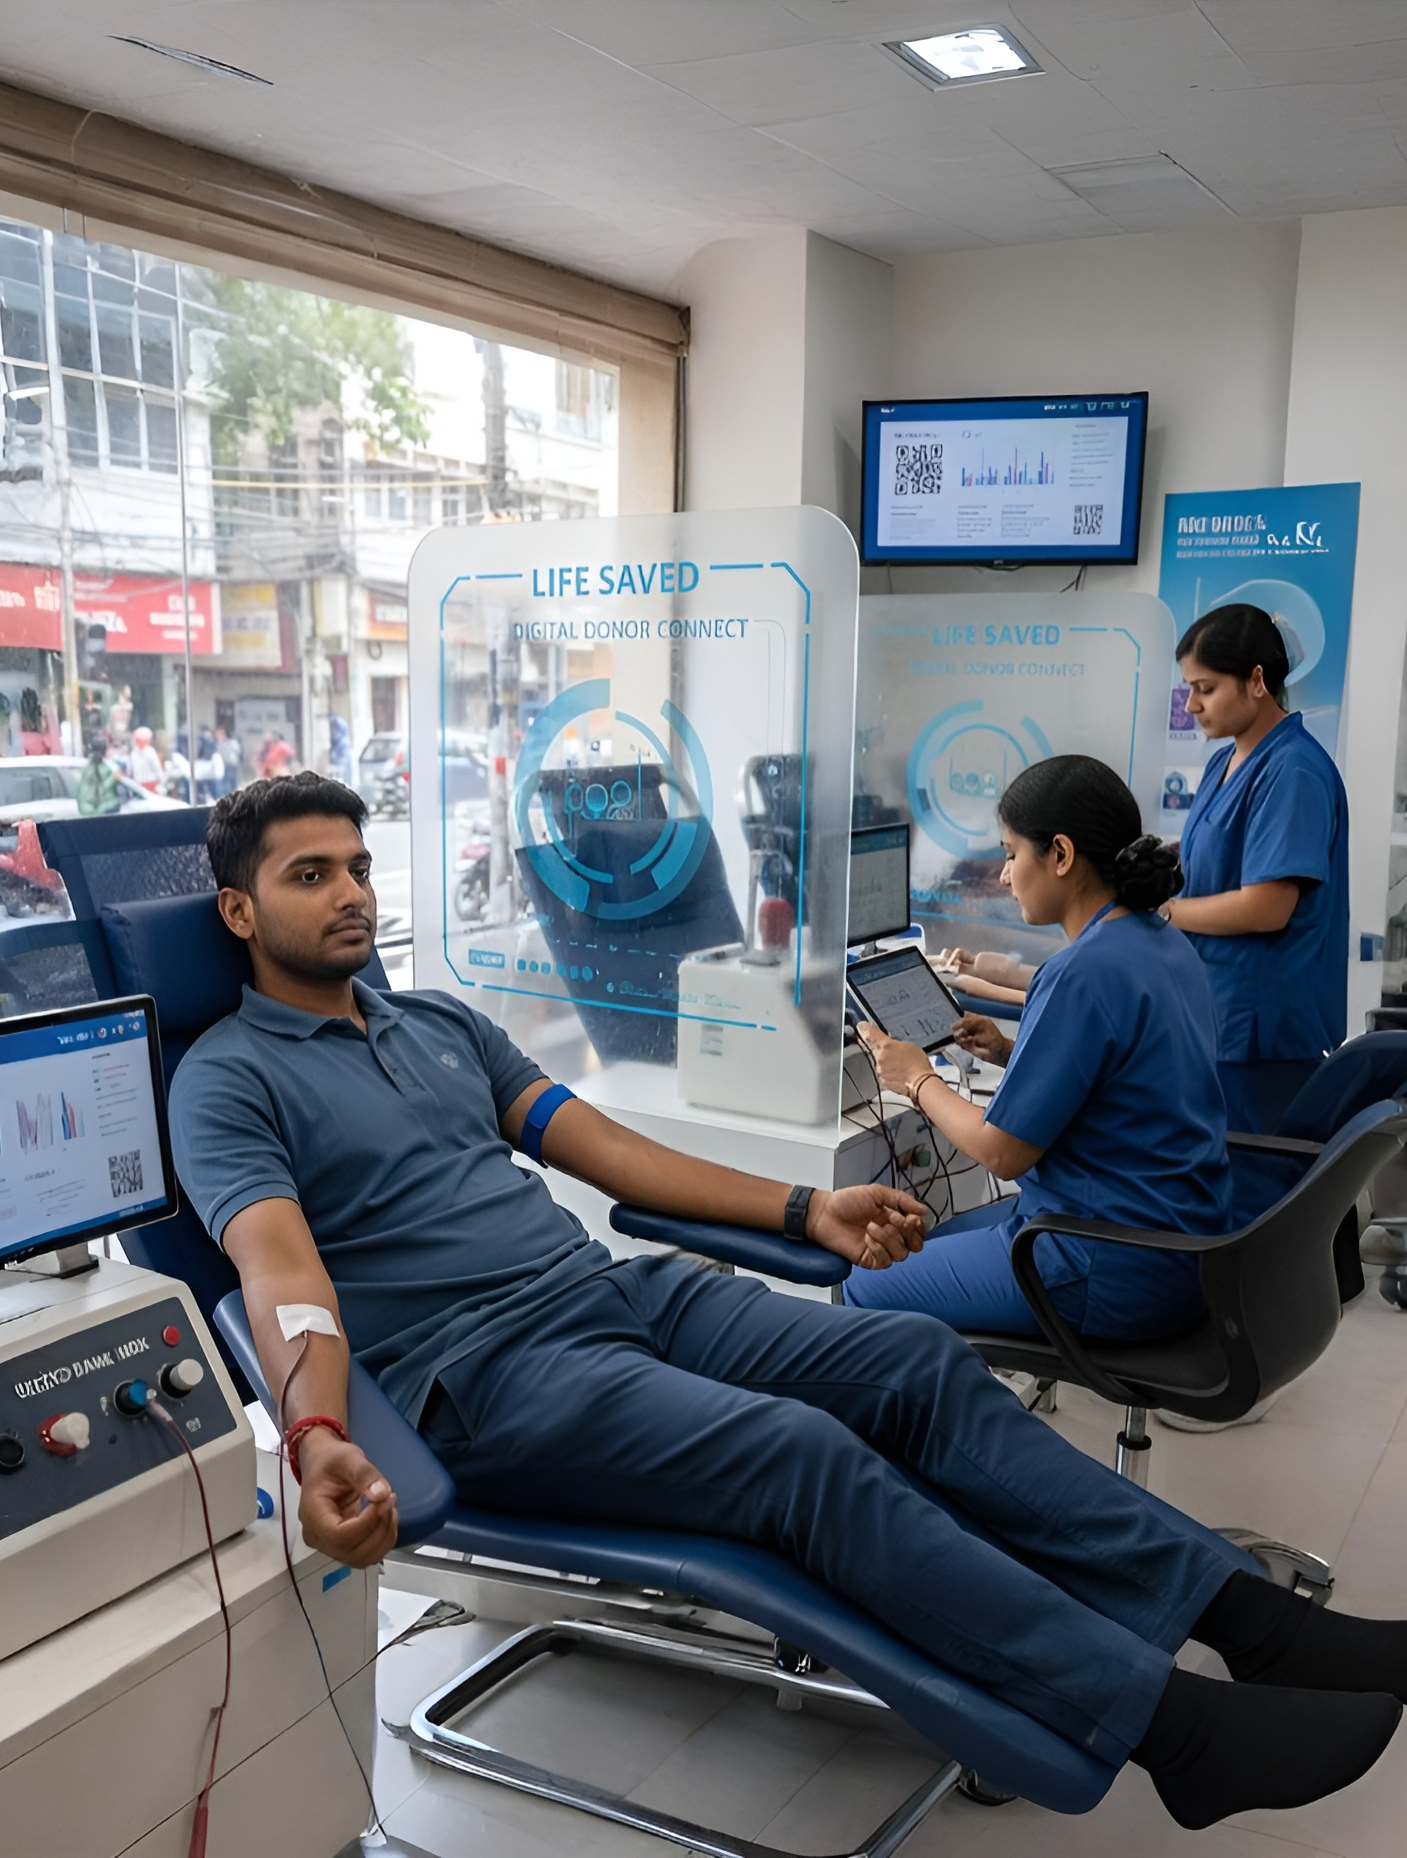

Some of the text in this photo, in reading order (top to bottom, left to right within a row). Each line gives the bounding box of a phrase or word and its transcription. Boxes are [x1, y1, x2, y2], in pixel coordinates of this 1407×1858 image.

[532, 561, 699, 597] LIFE SAVED
[513, 619, 749, 639] DIGITAL DONOR CONNECT
[932, 624, 1061, 646] LIFE SAVED
